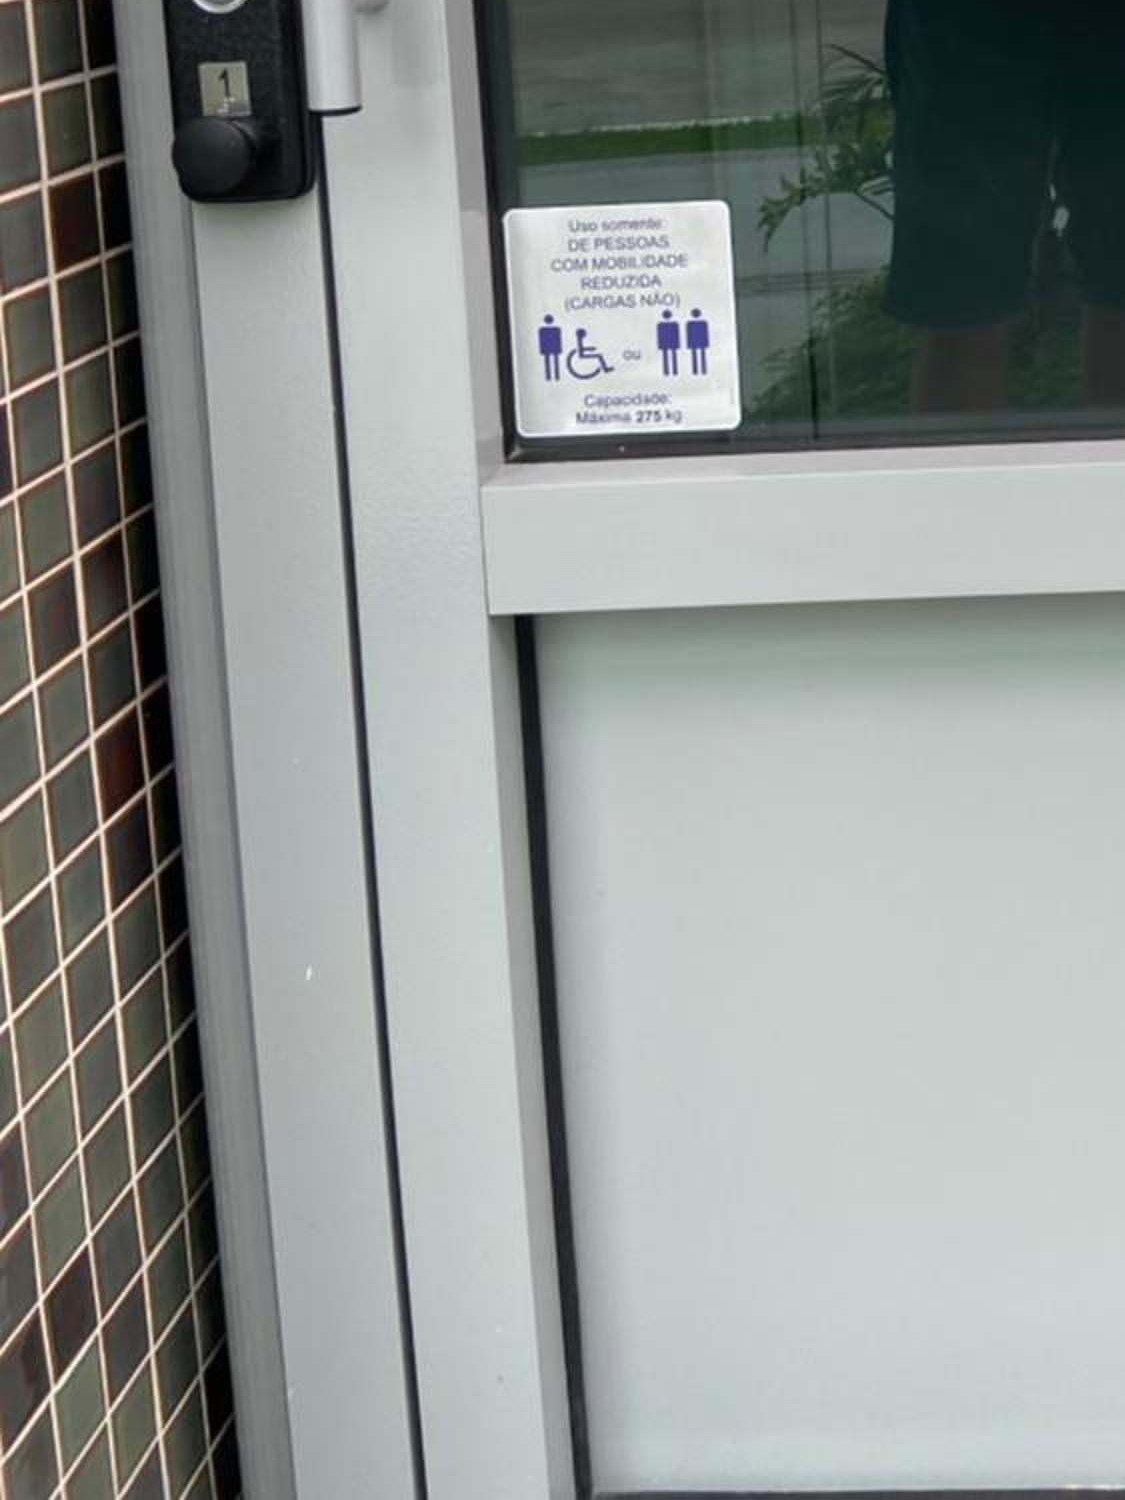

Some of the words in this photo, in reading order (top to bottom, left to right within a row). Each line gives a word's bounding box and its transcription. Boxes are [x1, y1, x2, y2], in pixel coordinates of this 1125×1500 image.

[568, 219, 598, 232] Uso
[568, 239, 590, 252] DE
[594, 235, 669, 250] PESSOAS
[551, 257, 588, 271] COM
[592, 254, 687, 270] MOBILIDADE
[581, 274, 661, 289] REDUZIDA
[565, 294, 637, 312] (CARGAS
[640, 290, 680, 308] NÃO)
[623, 351, 640, 360] ou
[635, 410, 662, 423] 275
[665, 408, 682, 424] kg
